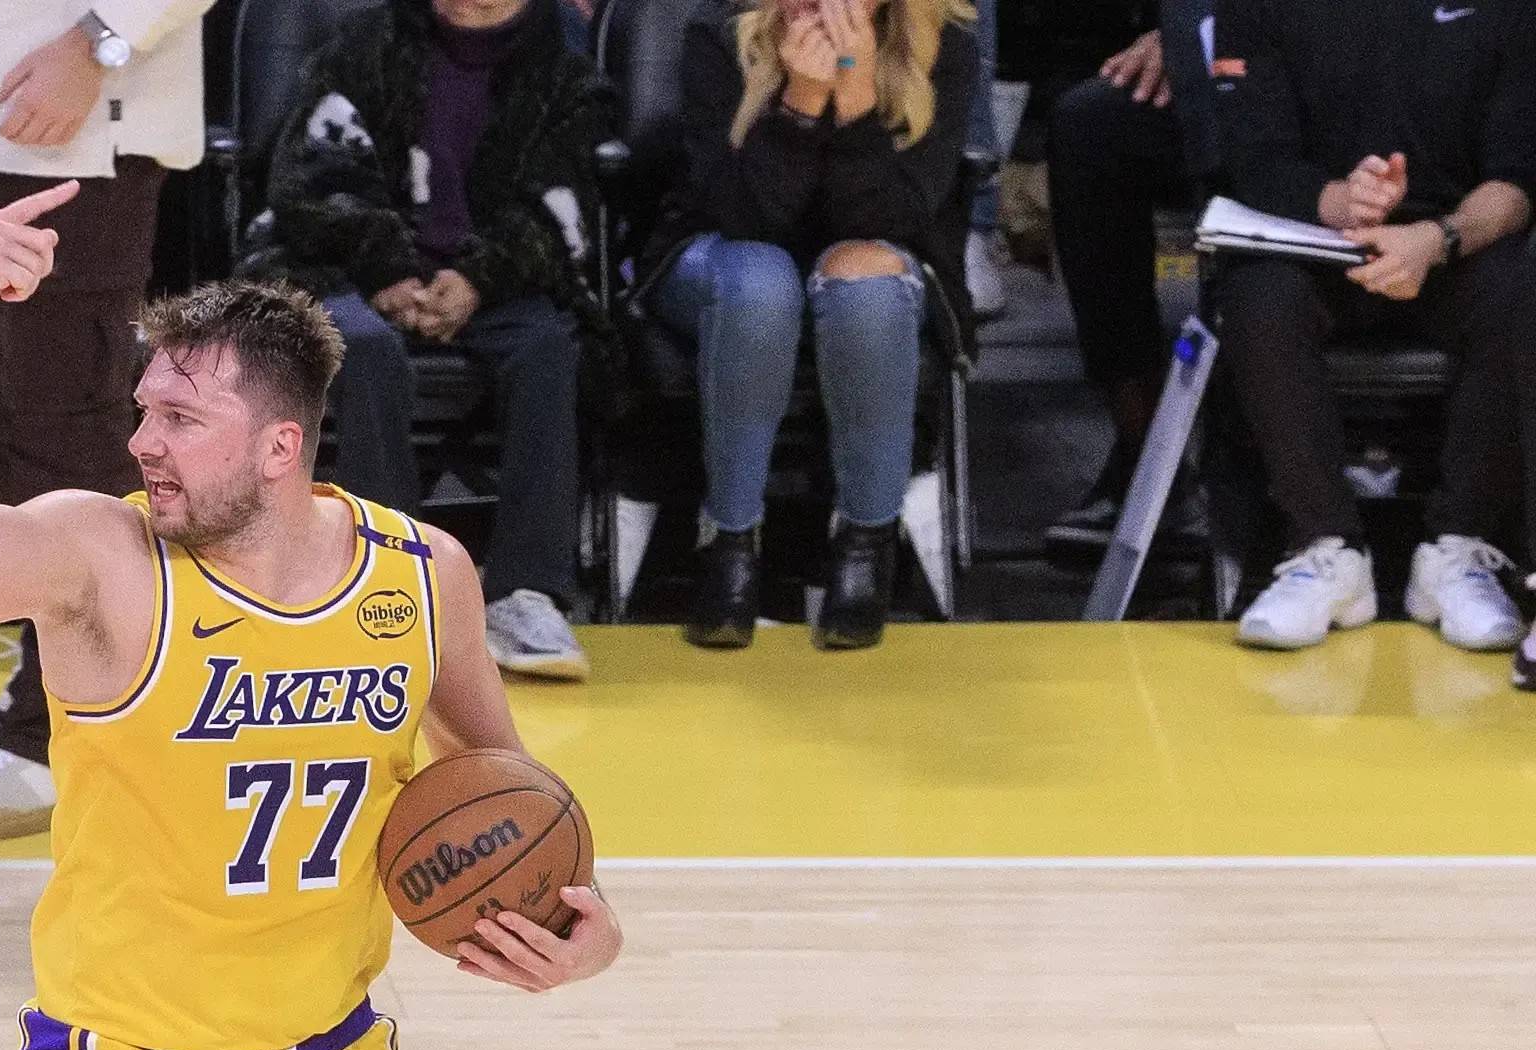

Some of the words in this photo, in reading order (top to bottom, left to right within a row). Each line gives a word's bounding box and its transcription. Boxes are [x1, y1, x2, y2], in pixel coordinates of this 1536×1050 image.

[385, 536, 403, 550] 44
[362, 602, 414, 623] bibigo
[172, 656, 411, 742] LAKERS
[225, 757, 371, 896] 77
[398, 818, 524, 906] Wilson
